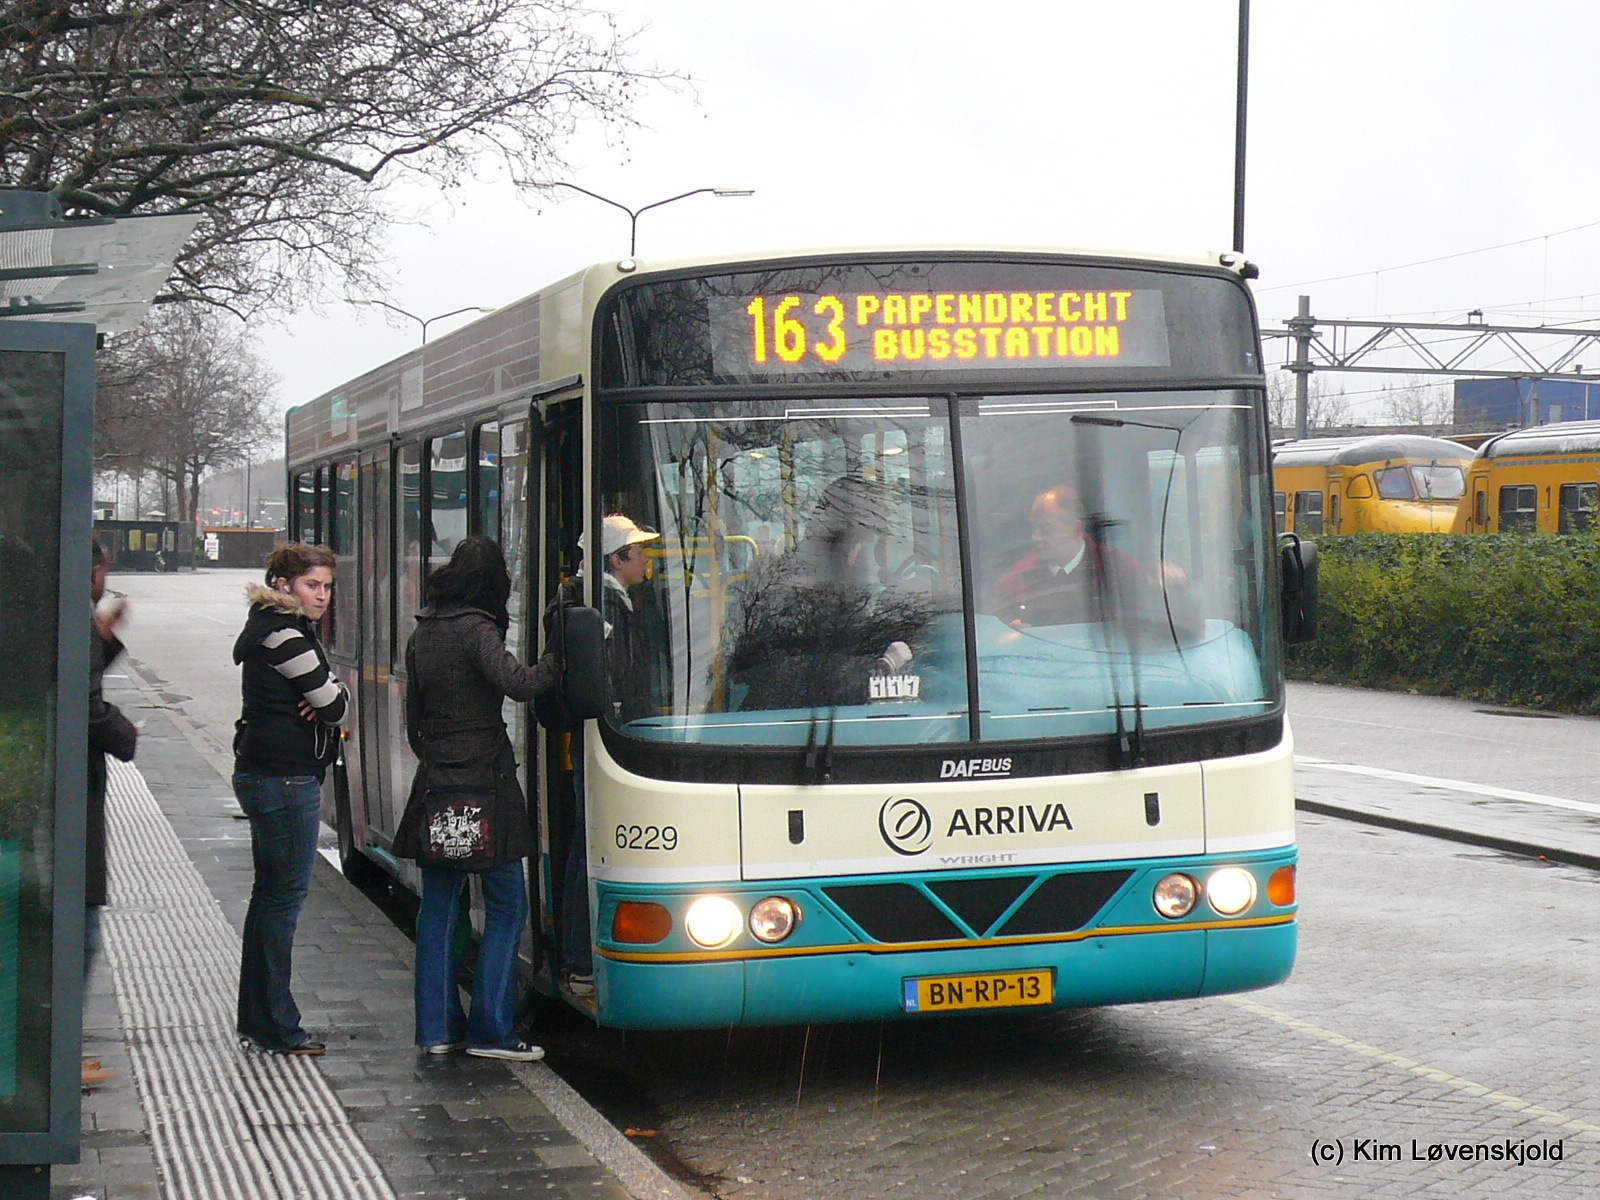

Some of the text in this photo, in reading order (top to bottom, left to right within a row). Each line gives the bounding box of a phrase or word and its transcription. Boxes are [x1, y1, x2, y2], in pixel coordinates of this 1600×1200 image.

[857, 291, 1132, 326] PAPENDRECHT
[747, 295, 846, 363] 163
[874, 325, 1120, 361] BUSSTATION
[946, 803, 1074, 838] ARRIVA
[615, 824, 678, 851] 6229
[939, 852, 1018, 865] WRIGHT
[906, 999, 917, 1008] NL
[929, 976, 1041, 1006] BN-RP-13
